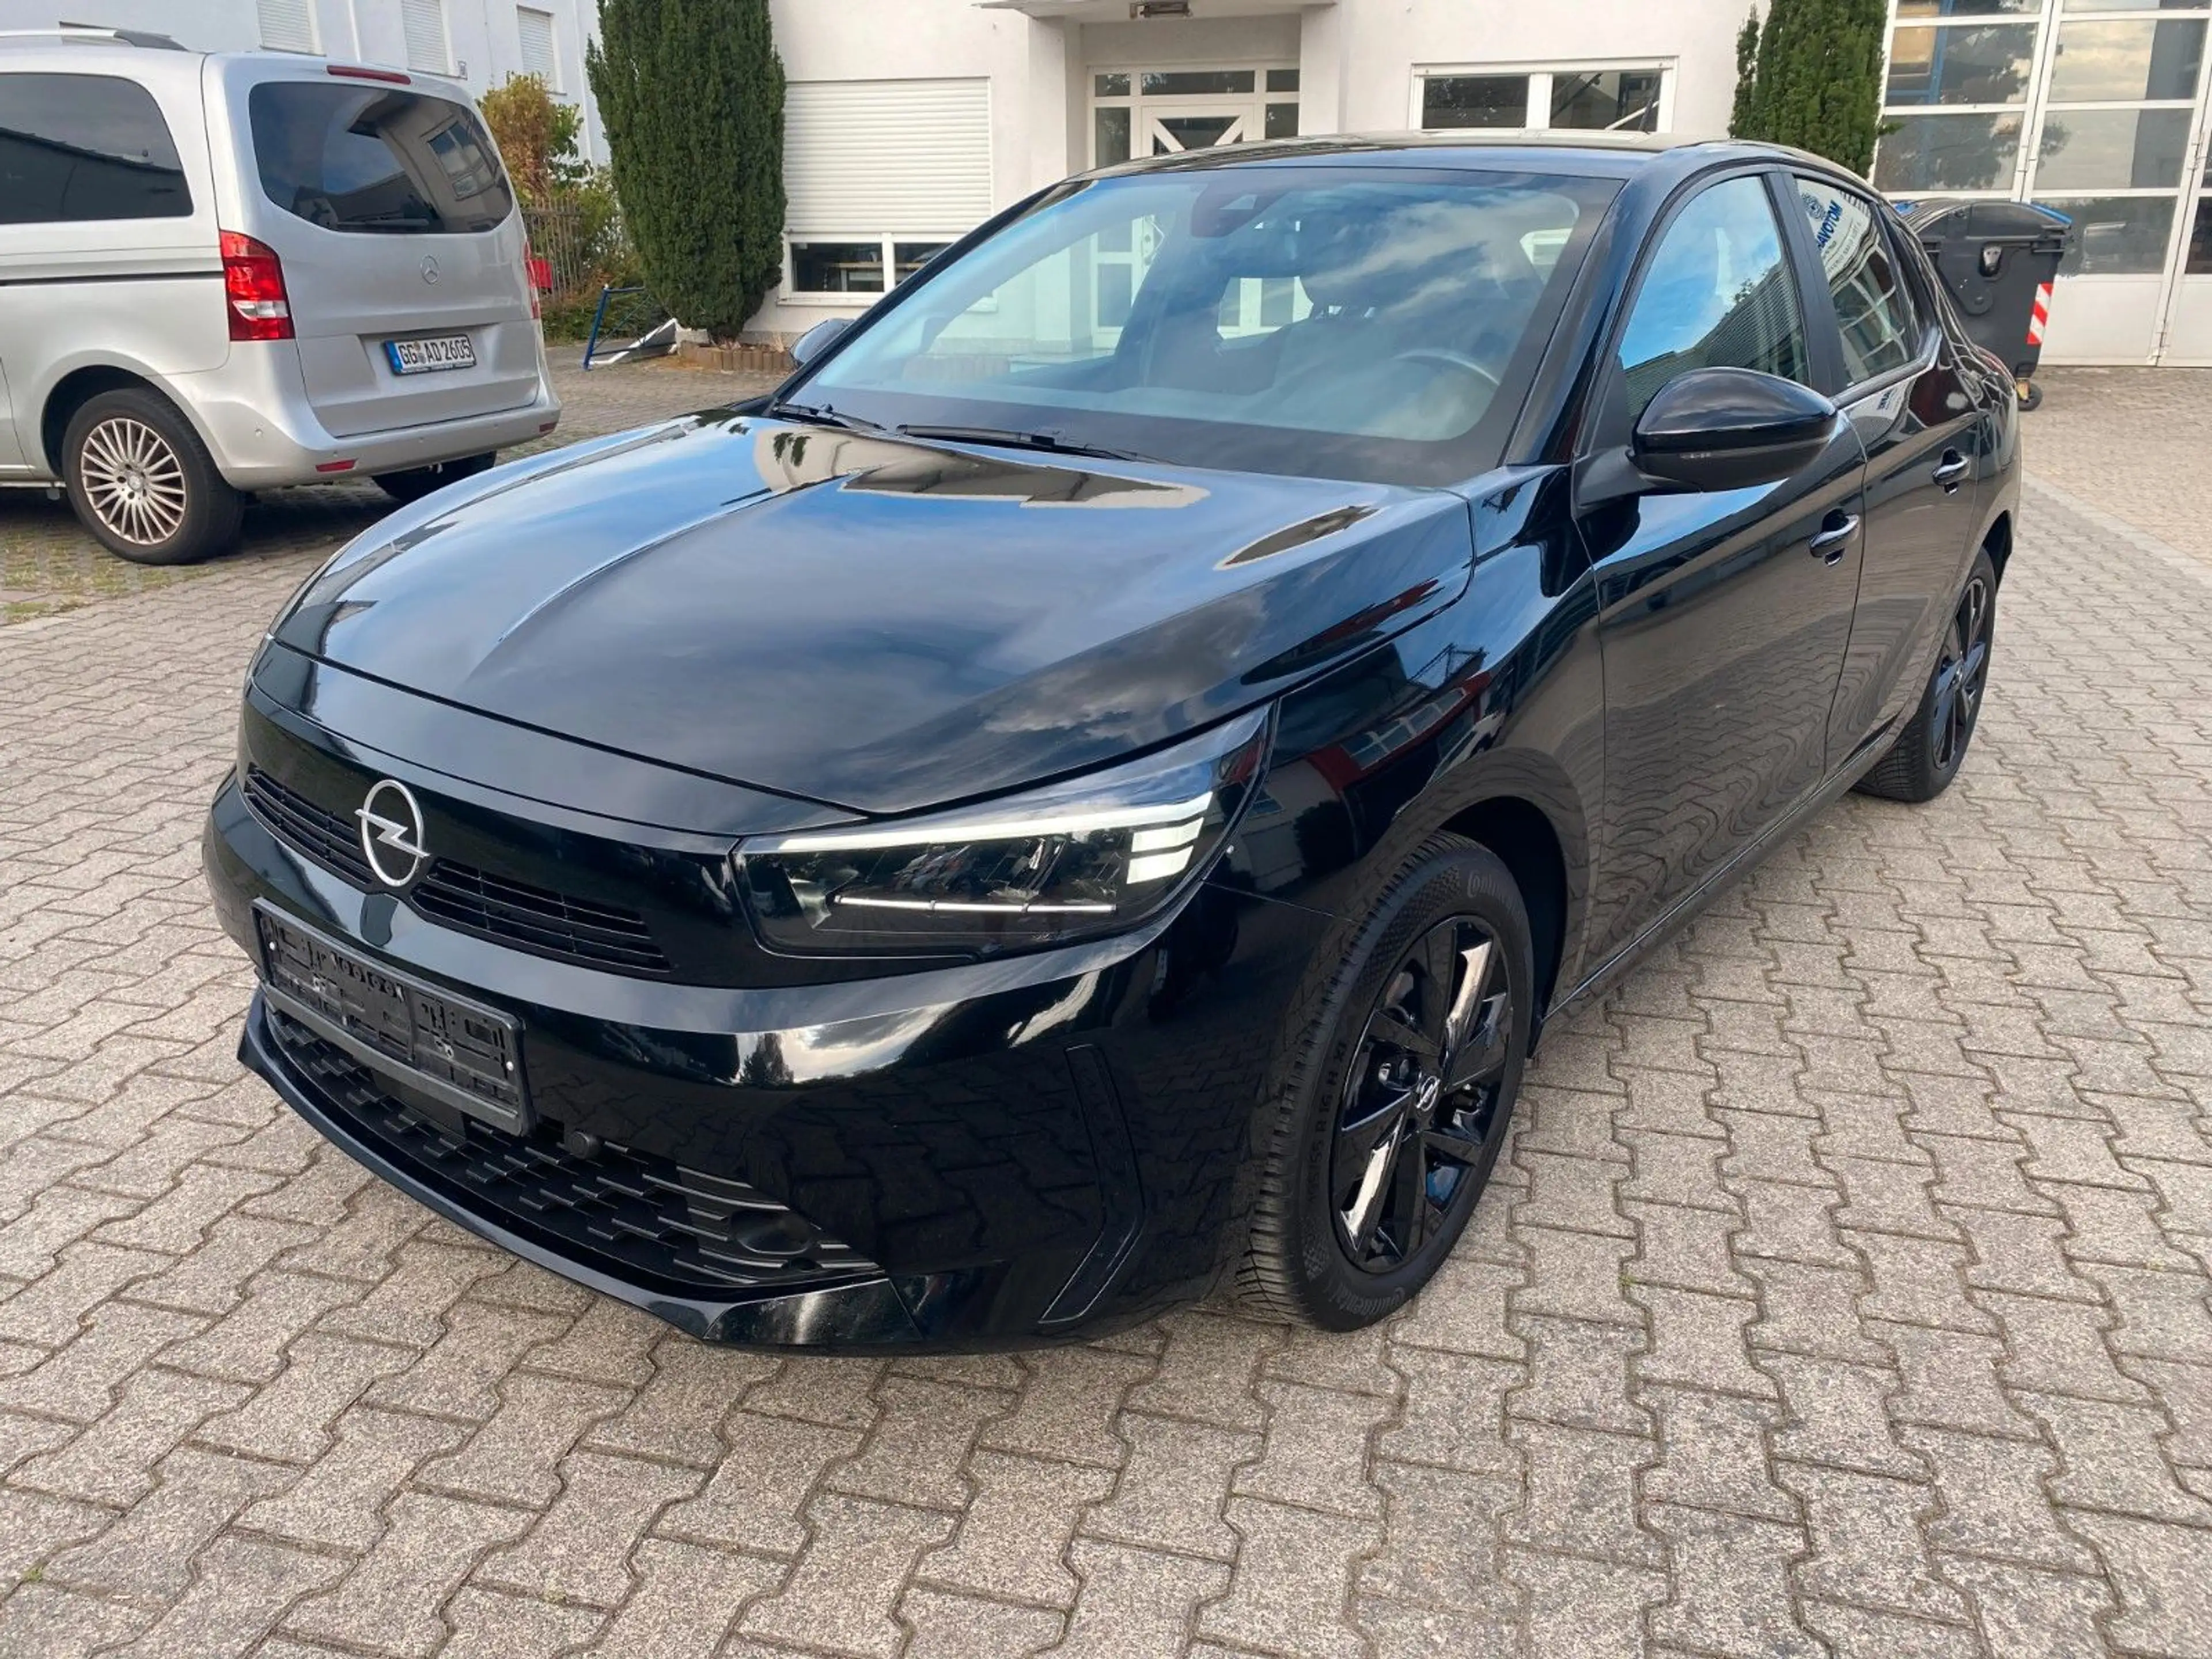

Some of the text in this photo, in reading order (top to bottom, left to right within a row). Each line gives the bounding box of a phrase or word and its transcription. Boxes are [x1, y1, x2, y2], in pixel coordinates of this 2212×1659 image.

[398, 340, 471, 364] GG AD 2605
